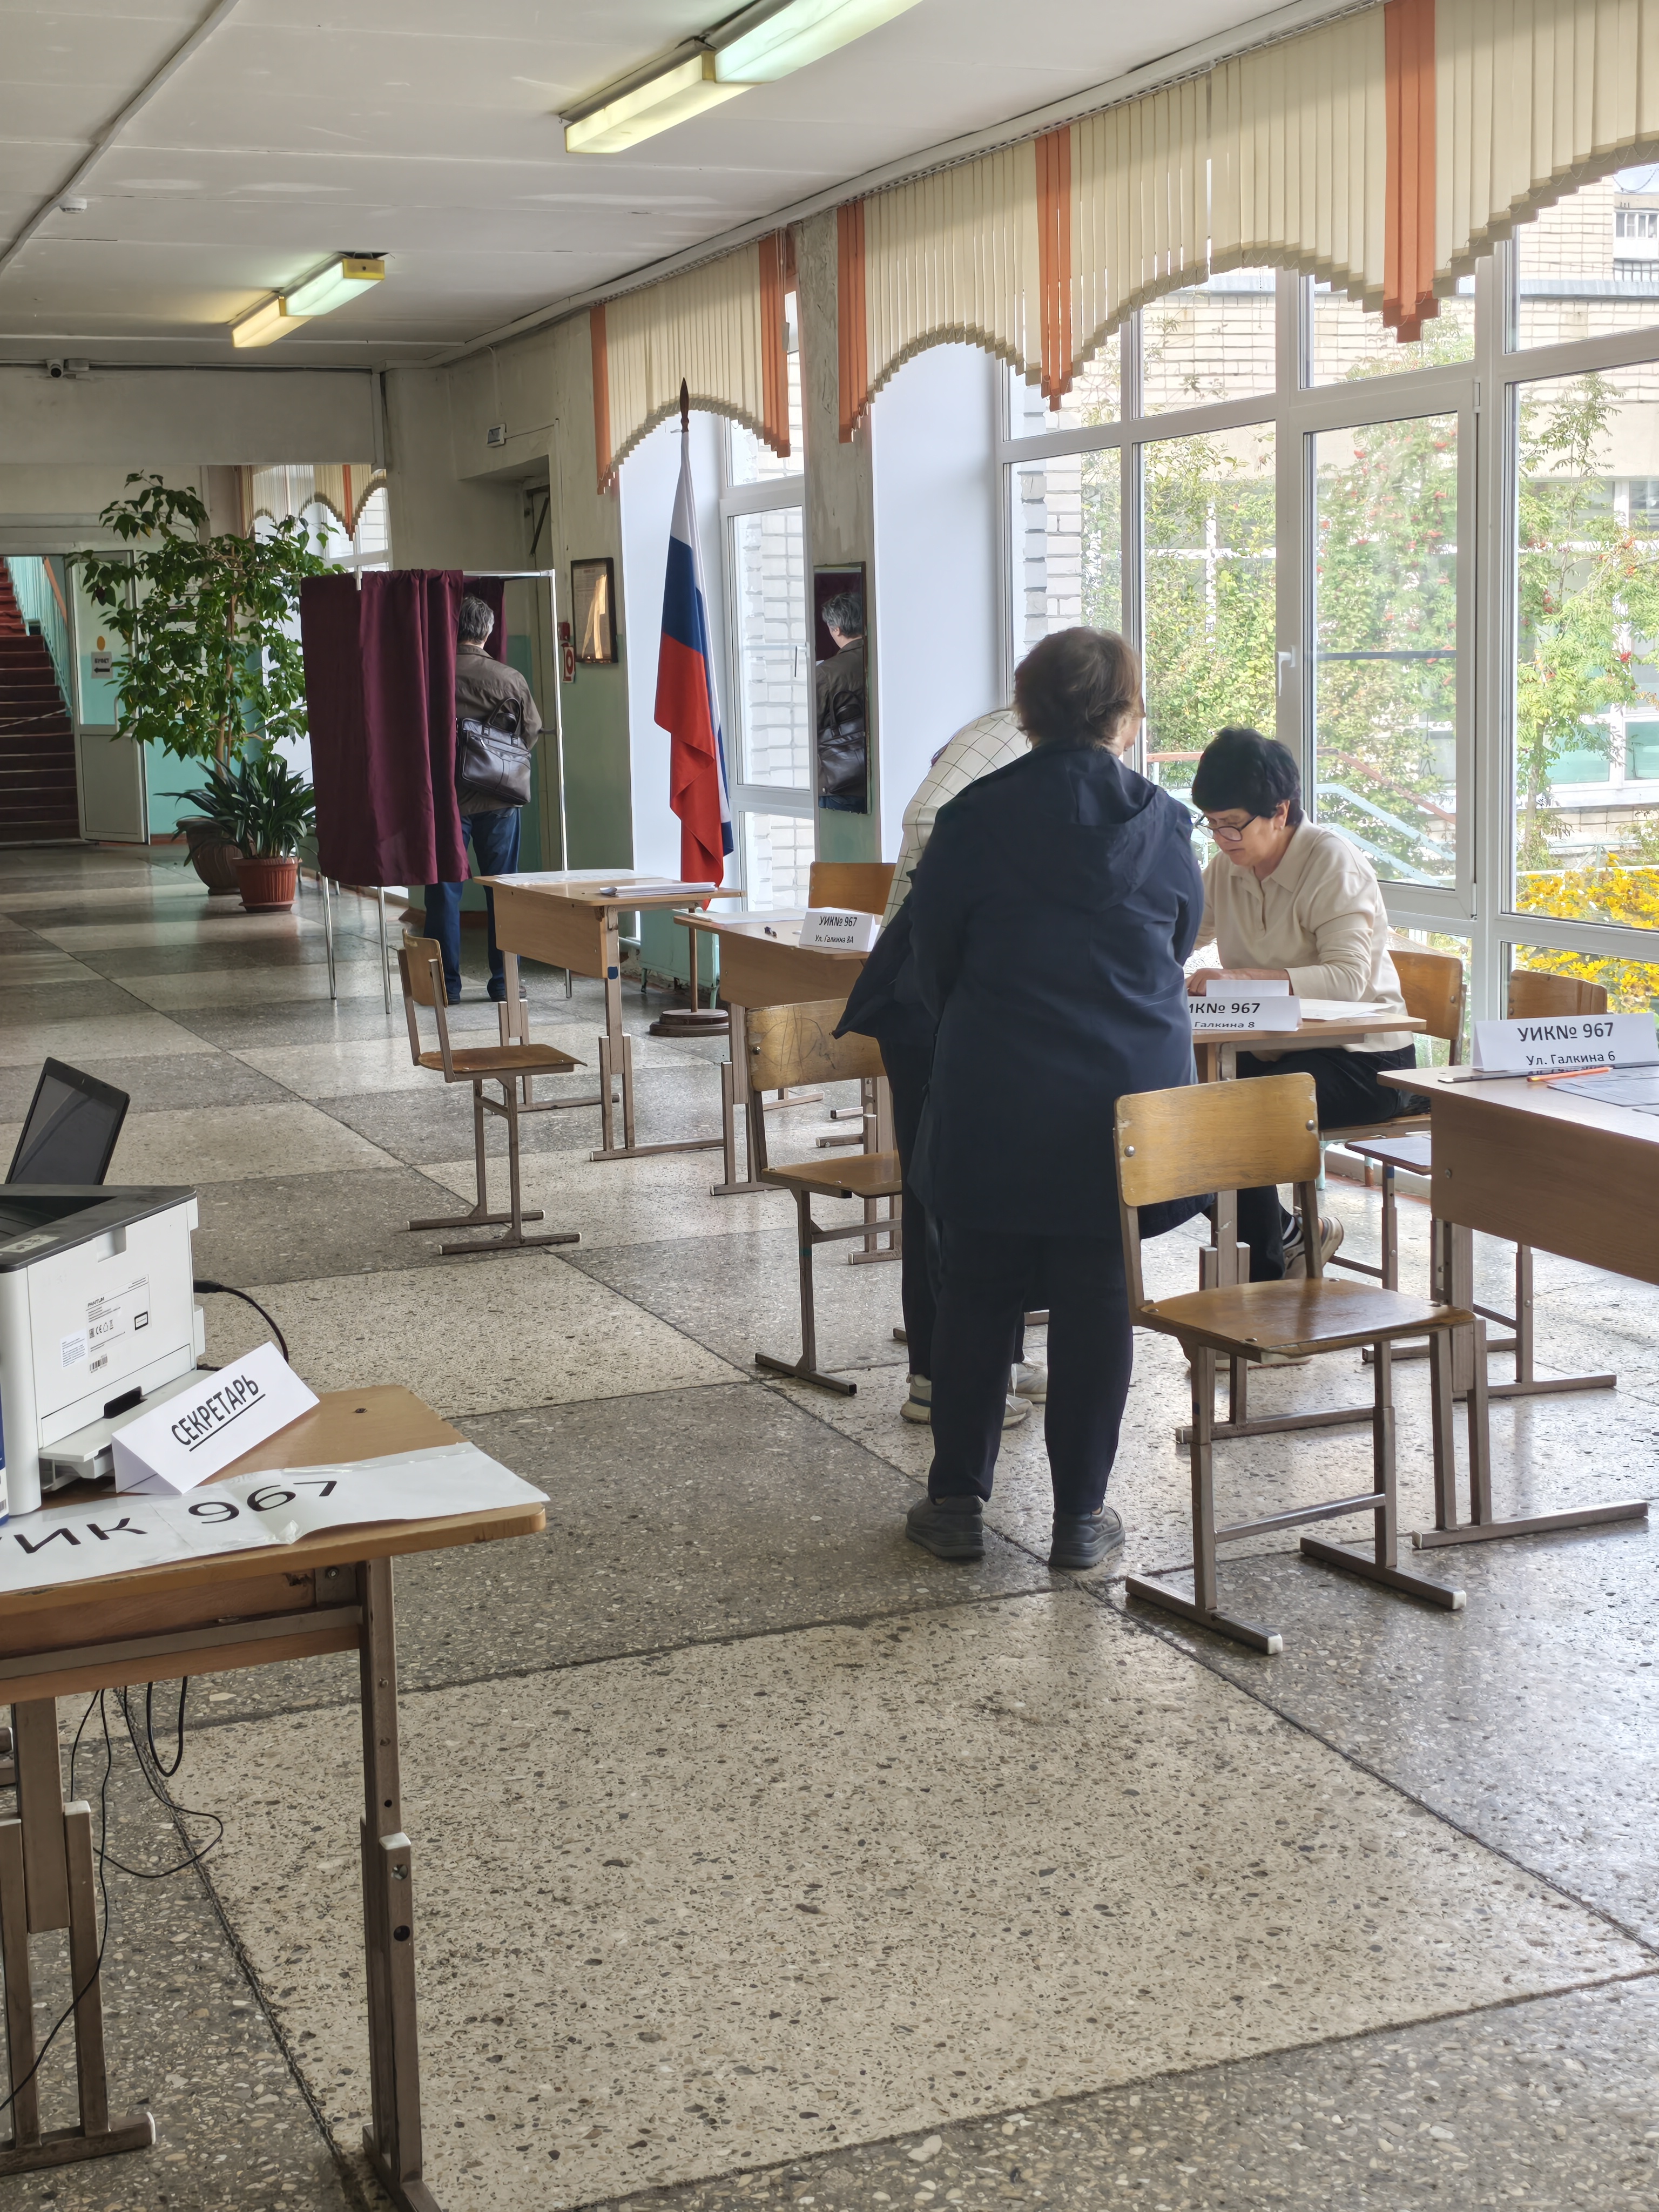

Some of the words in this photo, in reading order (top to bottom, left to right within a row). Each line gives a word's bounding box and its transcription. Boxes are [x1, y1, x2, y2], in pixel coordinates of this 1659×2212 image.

[819, 916, 842, 926] УИК№
[844, 916, 857, 927] 967
[1231, 1003, 1260, 1014] 967
[1518, 1025, 1578, 1042] УИК№
[1583, 1022, 1614, 1038] 967
[1526, 1056, 1547, 1065] Ул.
[1551, 1054, 1604, 1064] Галкина
[1608, 1051, 1615, 1061] 6
[171, 1374, 259, 1445] СЕКРЕТАРЬ
[0, 1517, 148, 1554] ИК
[188, 1480, 337, 1524] 967
